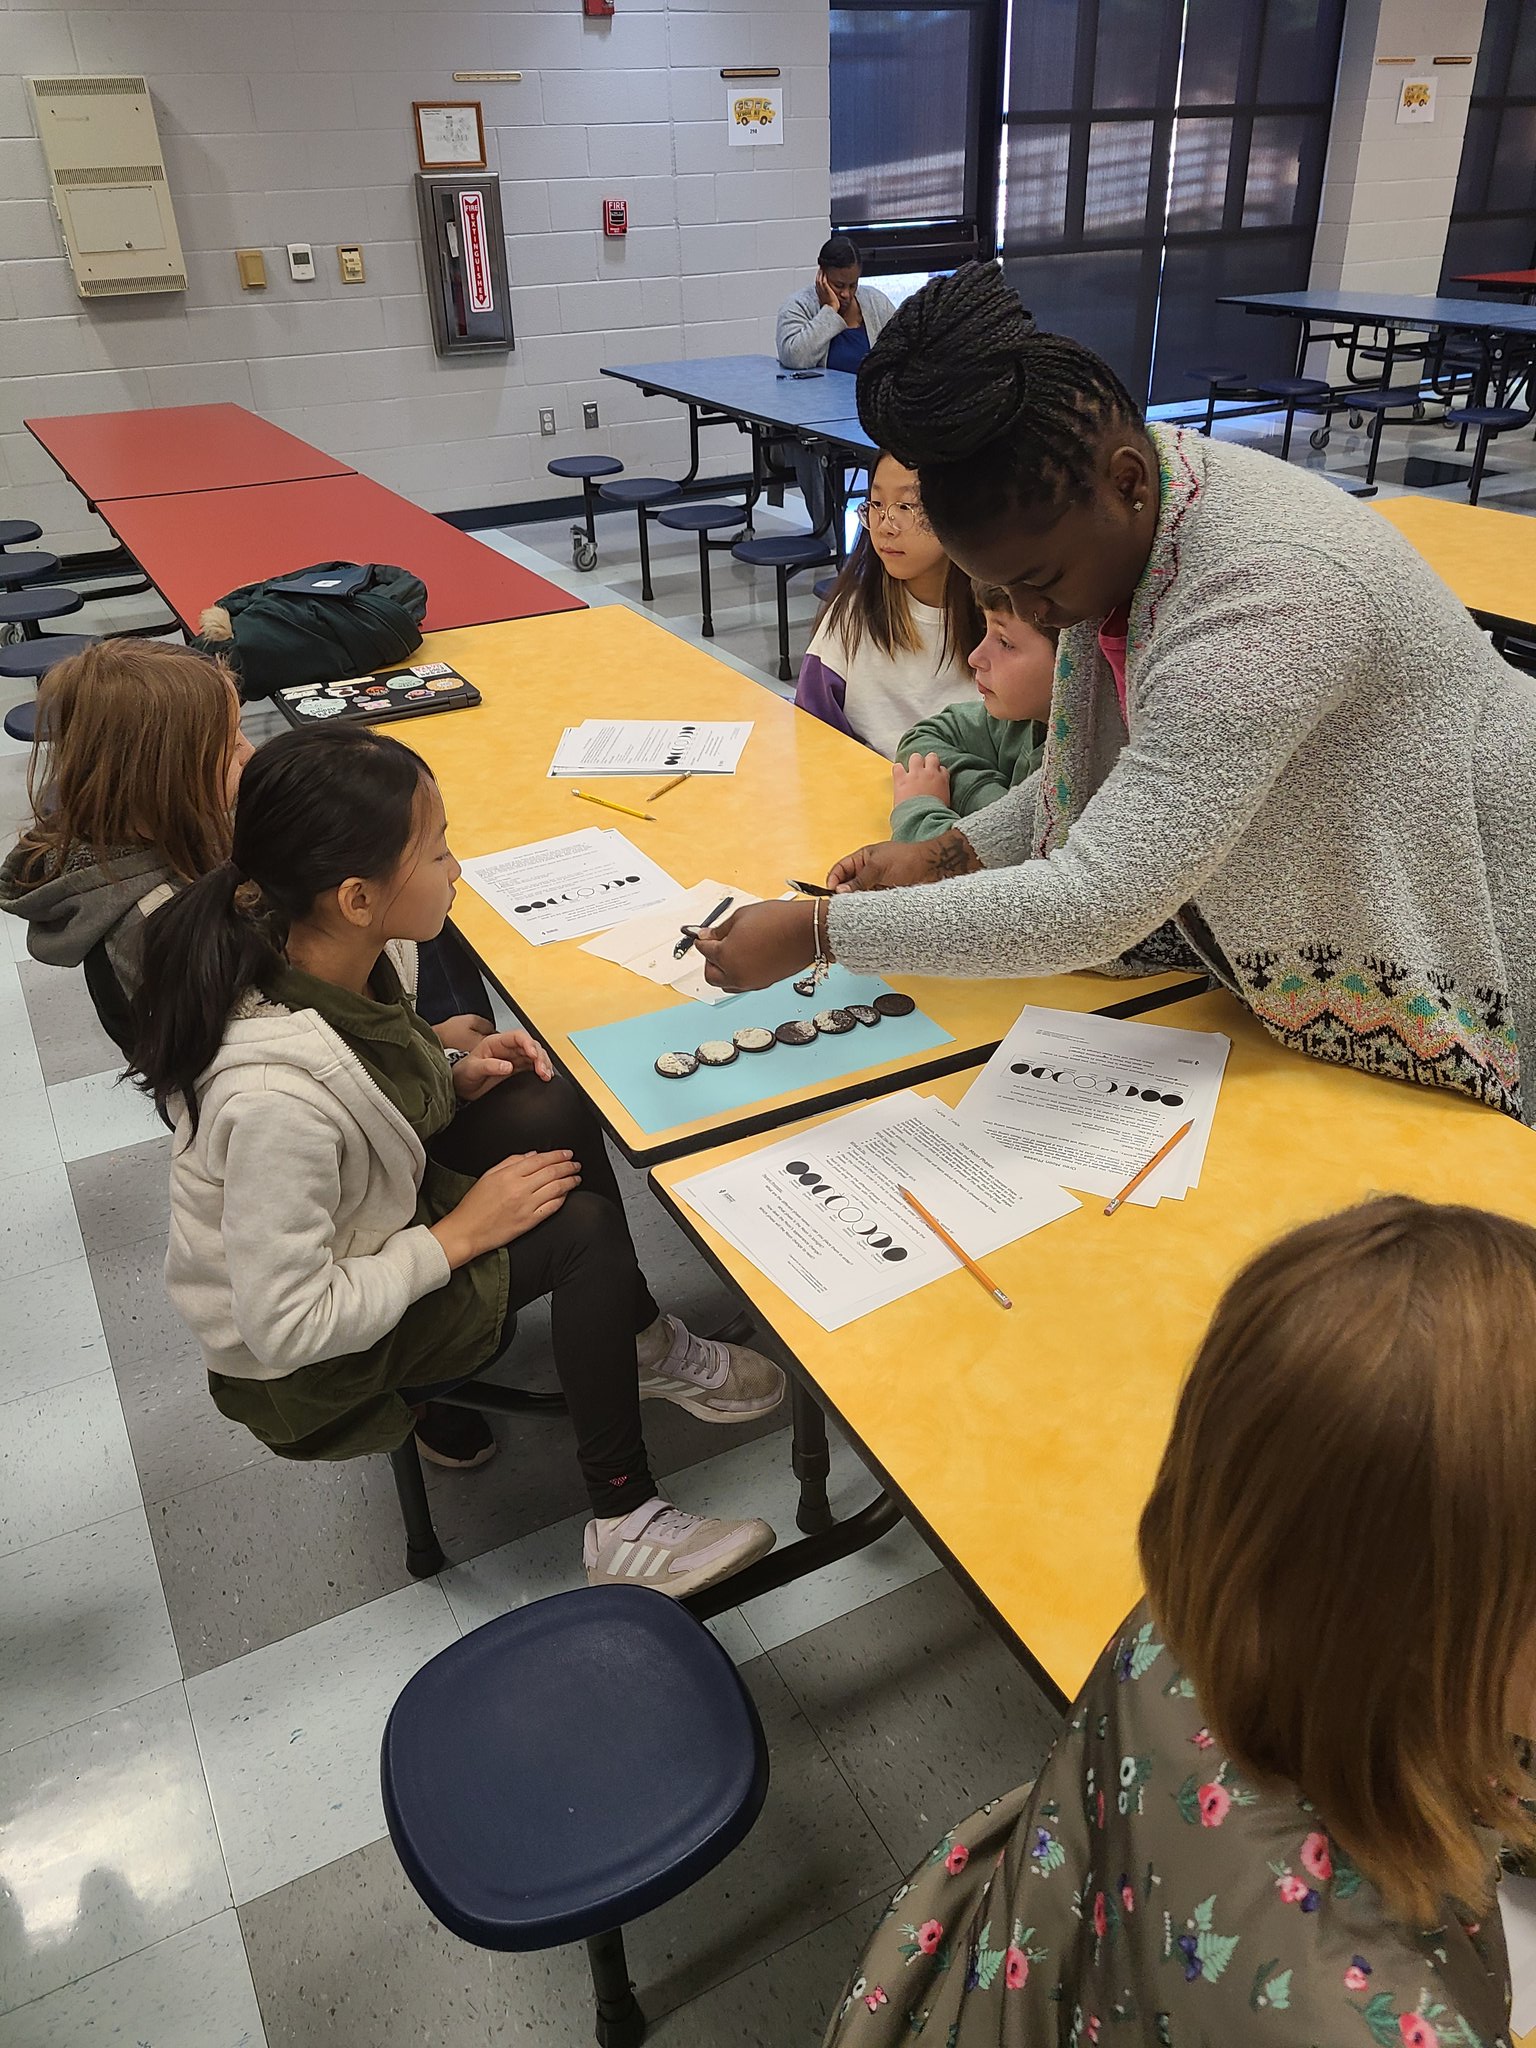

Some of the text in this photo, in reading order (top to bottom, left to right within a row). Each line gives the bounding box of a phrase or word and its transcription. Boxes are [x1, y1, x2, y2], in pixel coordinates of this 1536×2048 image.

[465, 204, 479, 212] FIRE
[608, 202, 625, 210] FIRE
[470, 213, 484, 301] EXTINGUISHER
